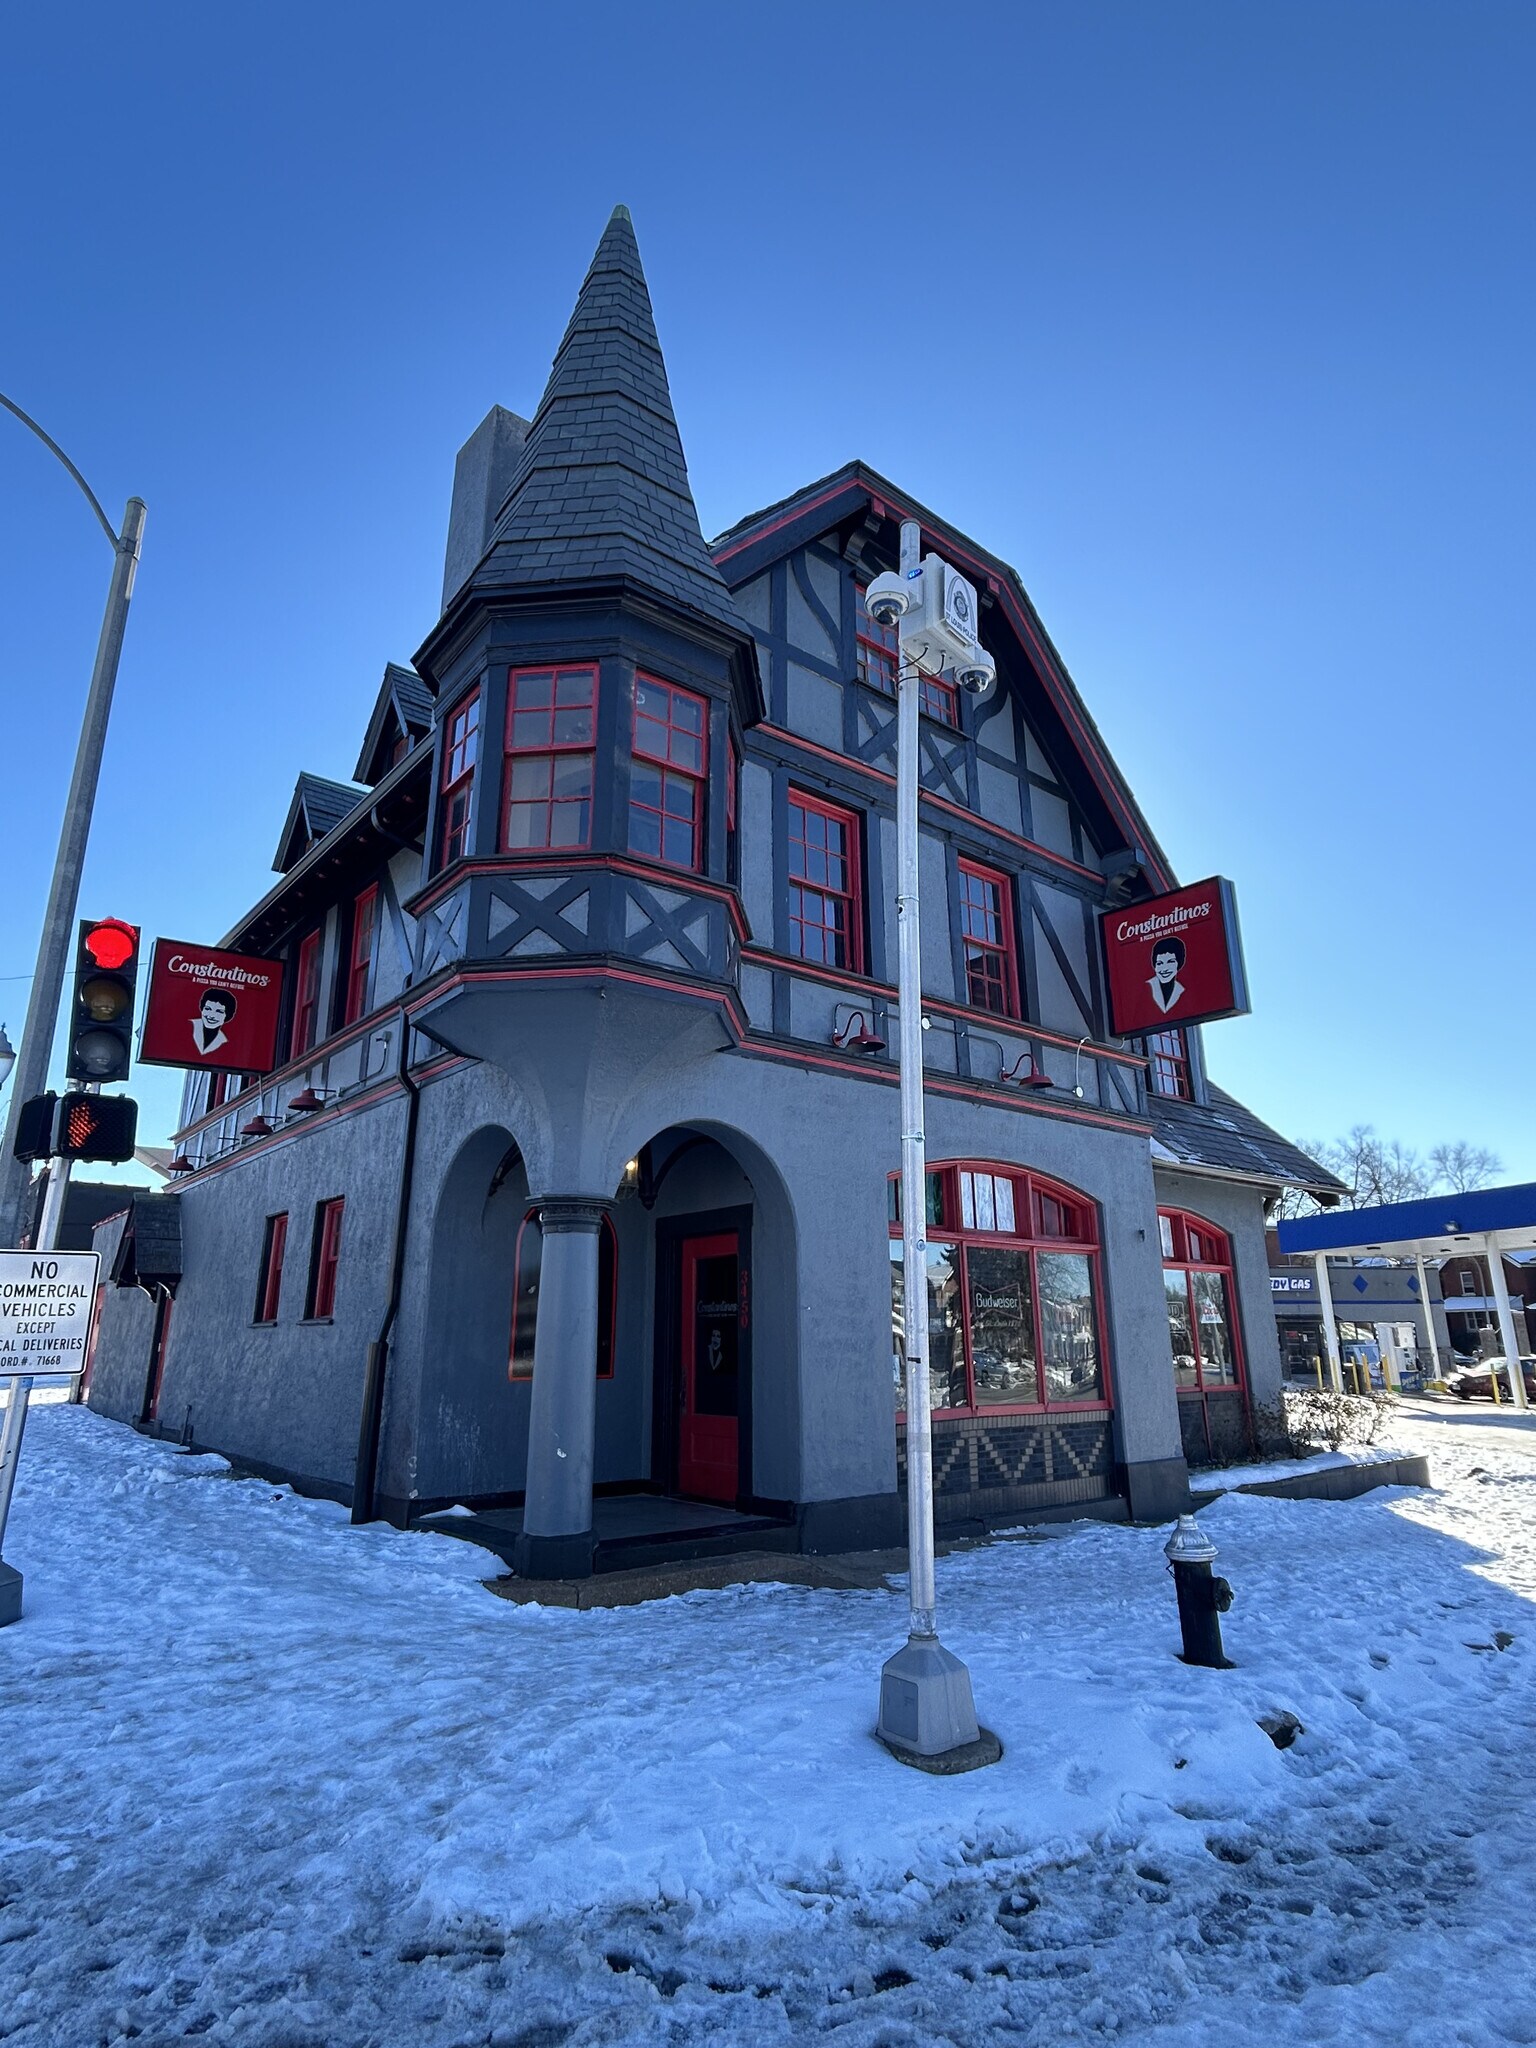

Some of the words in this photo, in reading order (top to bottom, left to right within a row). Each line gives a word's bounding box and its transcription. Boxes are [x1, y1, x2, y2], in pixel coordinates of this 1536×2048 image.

[1117, 902, 1212, 941] Constantinos
[168, 954, 271, 987] Constantinos
[31, 1261, 58, 1279] NO
[0, 1283, 88, 1298] OMMERCIAL
[1291, 1279, 1311, 1289] GAS
[976, 1292, 1018, 1308] Budweiser
[2, 1303, 76, 1317] VEHICLES
[16, 1322, 56, 1334] EXCEPT
[22, 1338, 83, 1351] DELIVERIES
[37, 1355, 61, 1366] 71668
